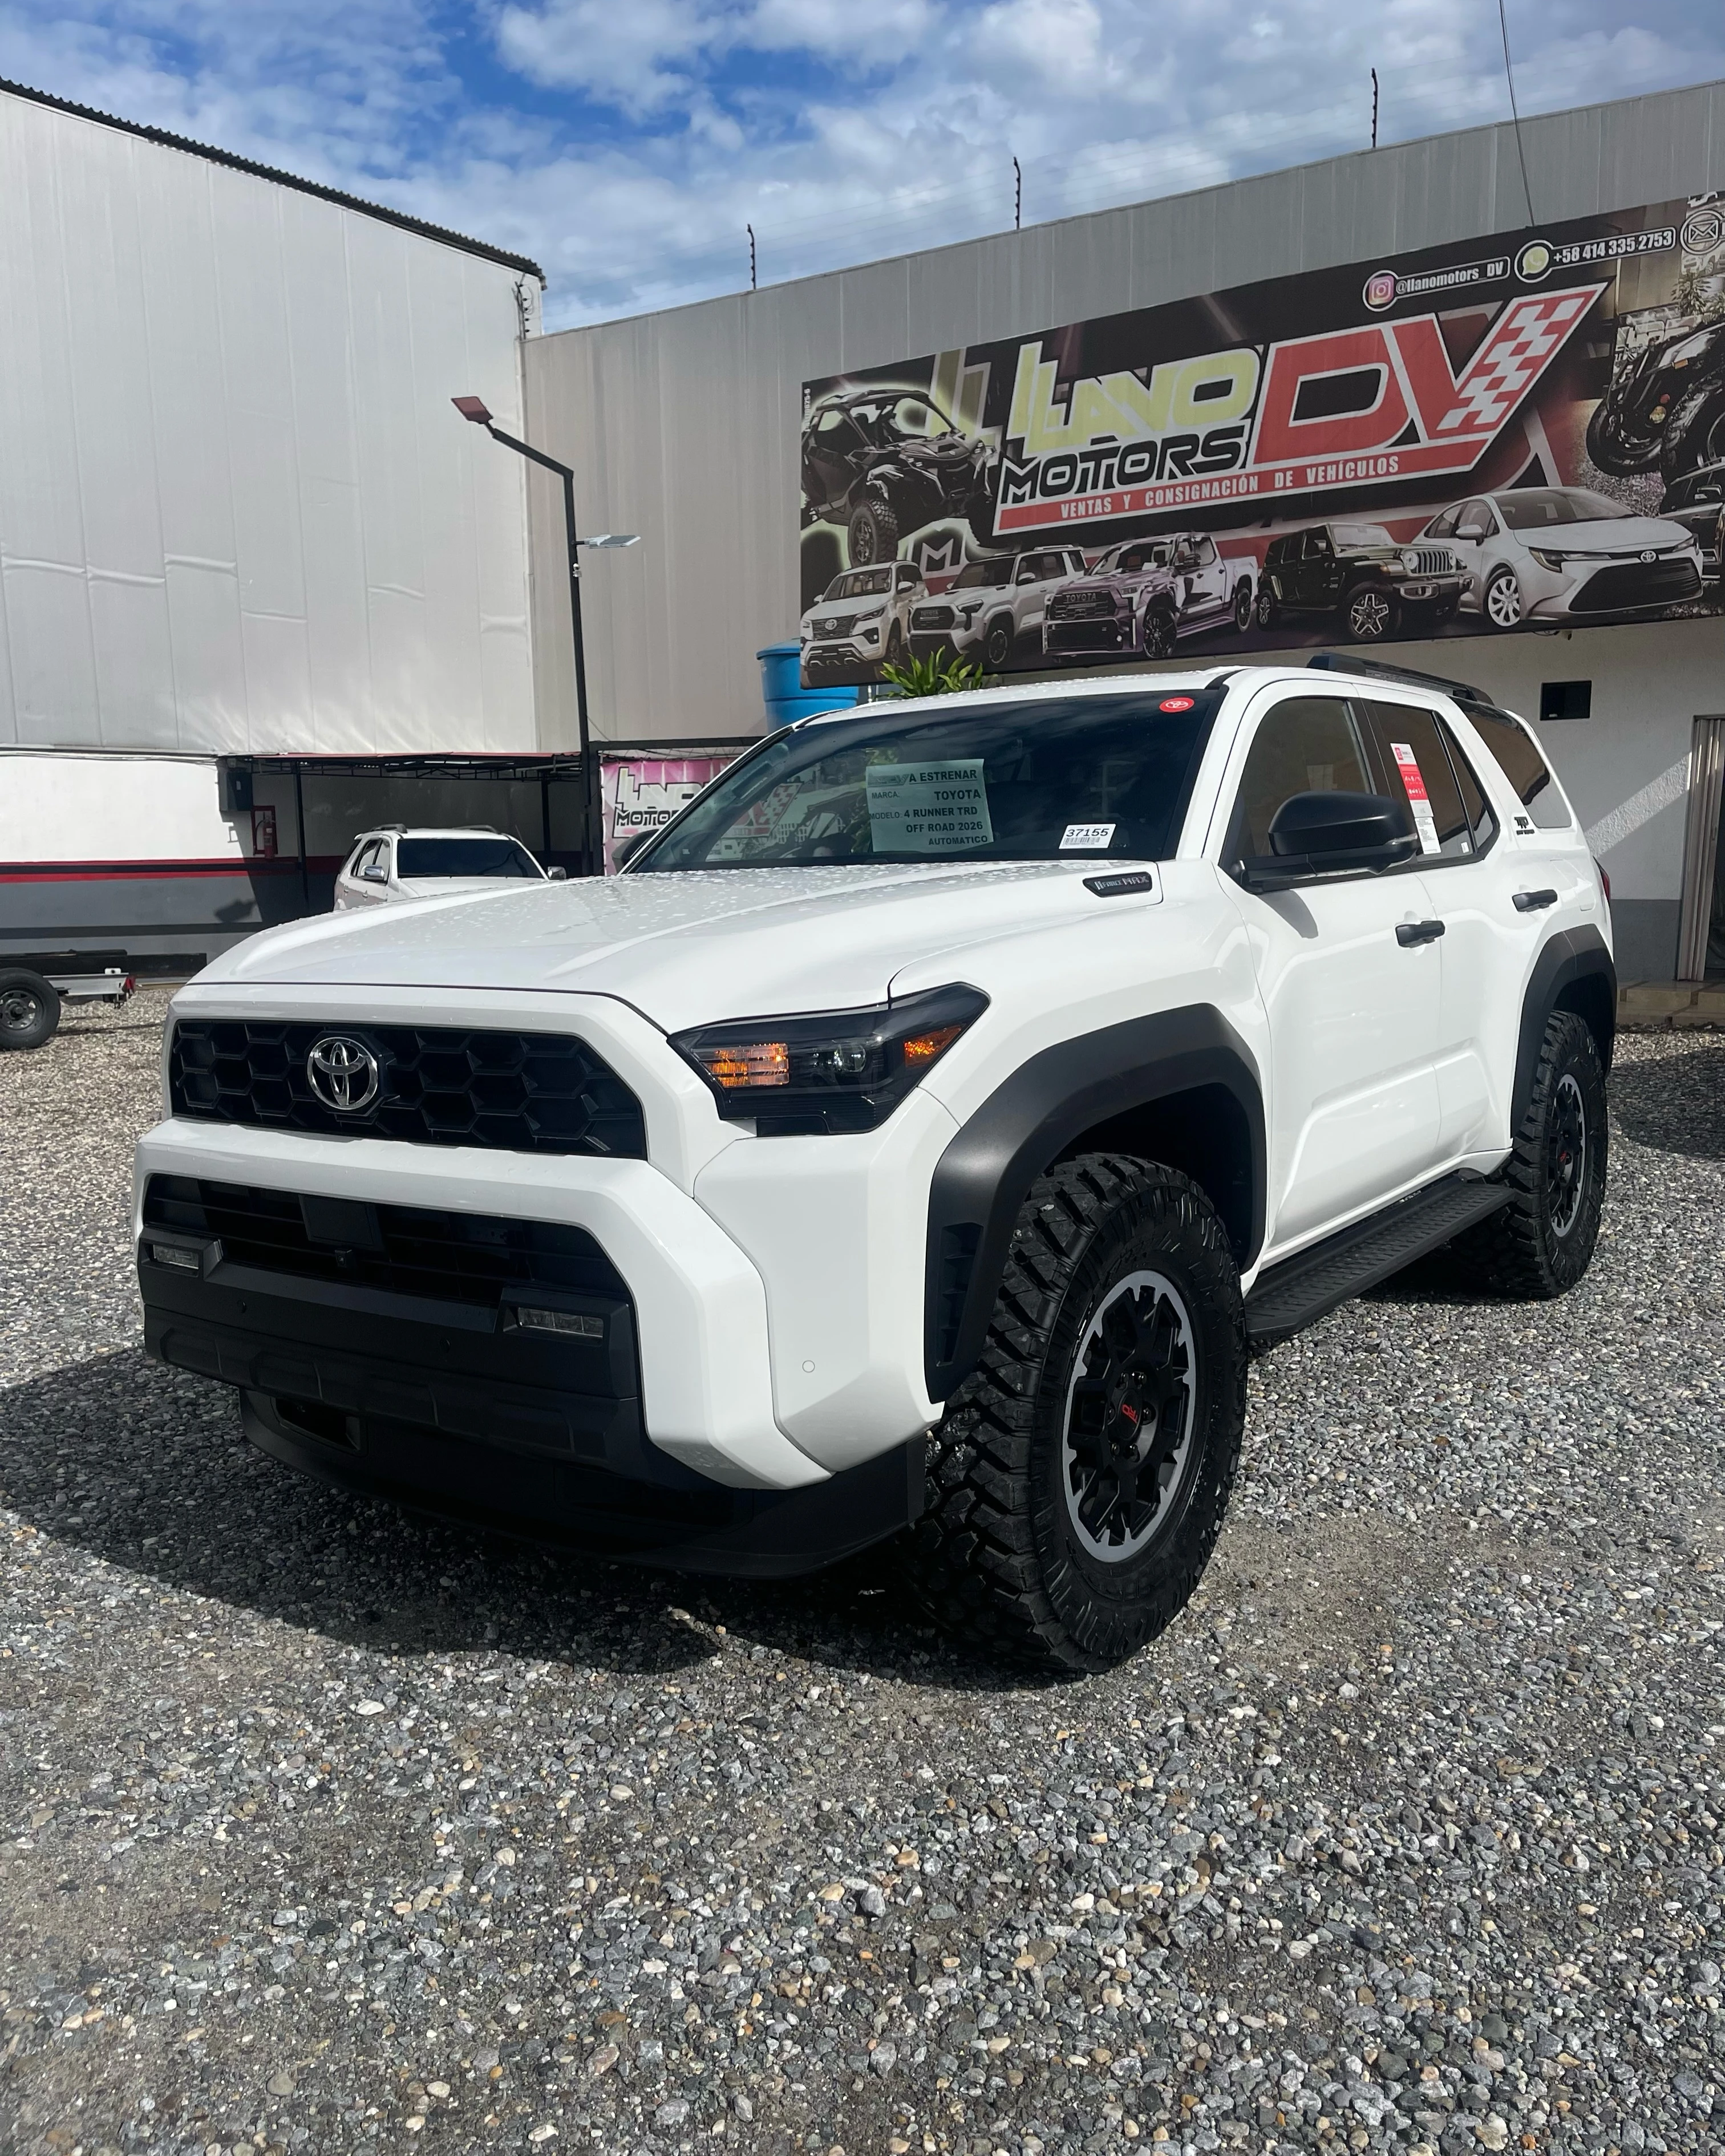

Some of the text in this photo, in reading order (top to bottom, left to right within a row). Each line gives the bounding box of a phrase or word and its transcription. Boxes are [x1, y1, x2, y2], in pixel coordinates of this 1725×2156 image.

[1553, 246, 1580, 264] +58
[1582, 242, 1606, 259] 414
[1252, 283, 1606, 465] DV
[1001, 425, 1246, 504] MOTORS
[1061, 456, 1399, 518] VENTAS Y CONSIGNACIÓN DE VEHÍCULOS
[1066, 593, 1096, 602] TOYOTA
[909, 773, 916, 783] A
[920, 769, 977, 782] ESTRENAR
[934, 789, 981, 801] TOYOTA
[913, 807, 955, 817] RUNNER
[957, 806, 978, 816] TRD
[906, 821, 983, 833] OFF ROAD 2026
[1066, 828, 1109, 837] 37155
[928, 835, 988, 845] AUTOMATICO
